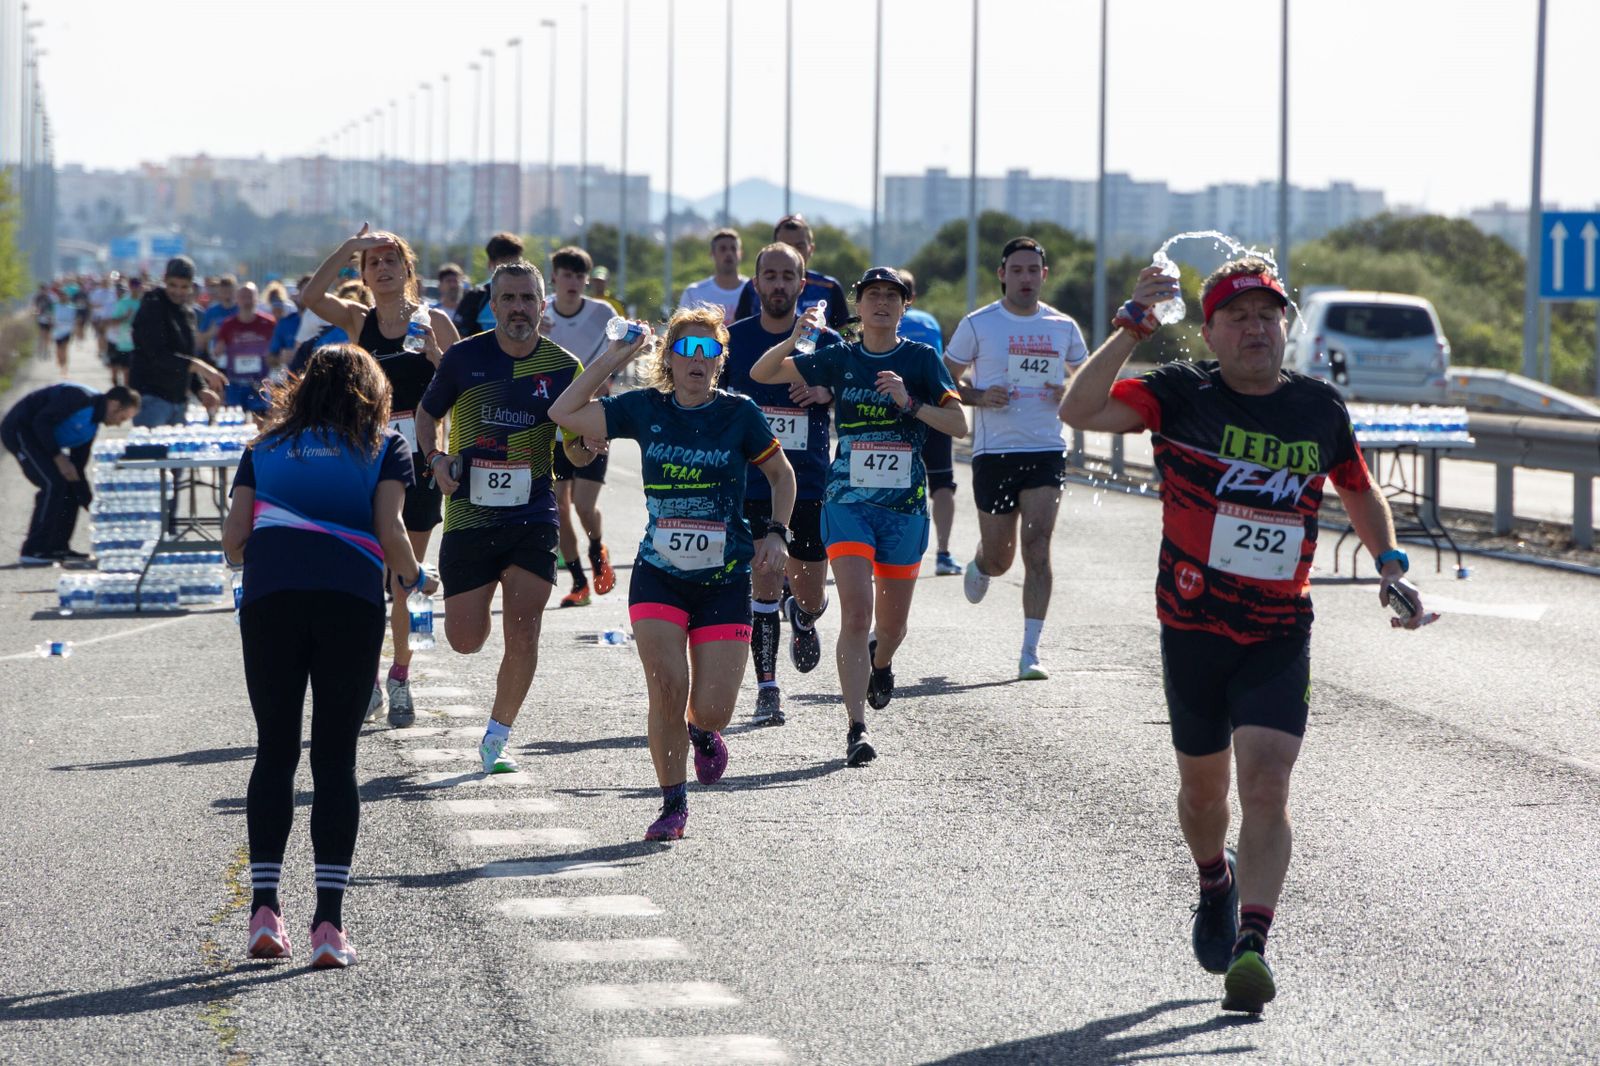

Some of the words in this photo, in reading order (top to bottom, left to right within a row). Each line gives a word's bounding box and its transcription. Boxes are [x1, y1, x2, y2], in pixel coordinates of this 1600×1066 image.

[1020, 358, 1049, 373] 442
[494, 407, 536, 425] Arbolito
[857, 404, 887, 418] TEAM
[646, 441, 731, 467] AGAPORNIS
[1223, 430, 1319, 472] LERUS
[863, 453, 898, 471] 472
[488, 472, 512, 489] 82
[662, 463, 703, 482] TEAM
[1215, 458, 1324, 506] TEAM
[669, 532, 709, 551] 570
[1233, 524, 1287, 555] 252
